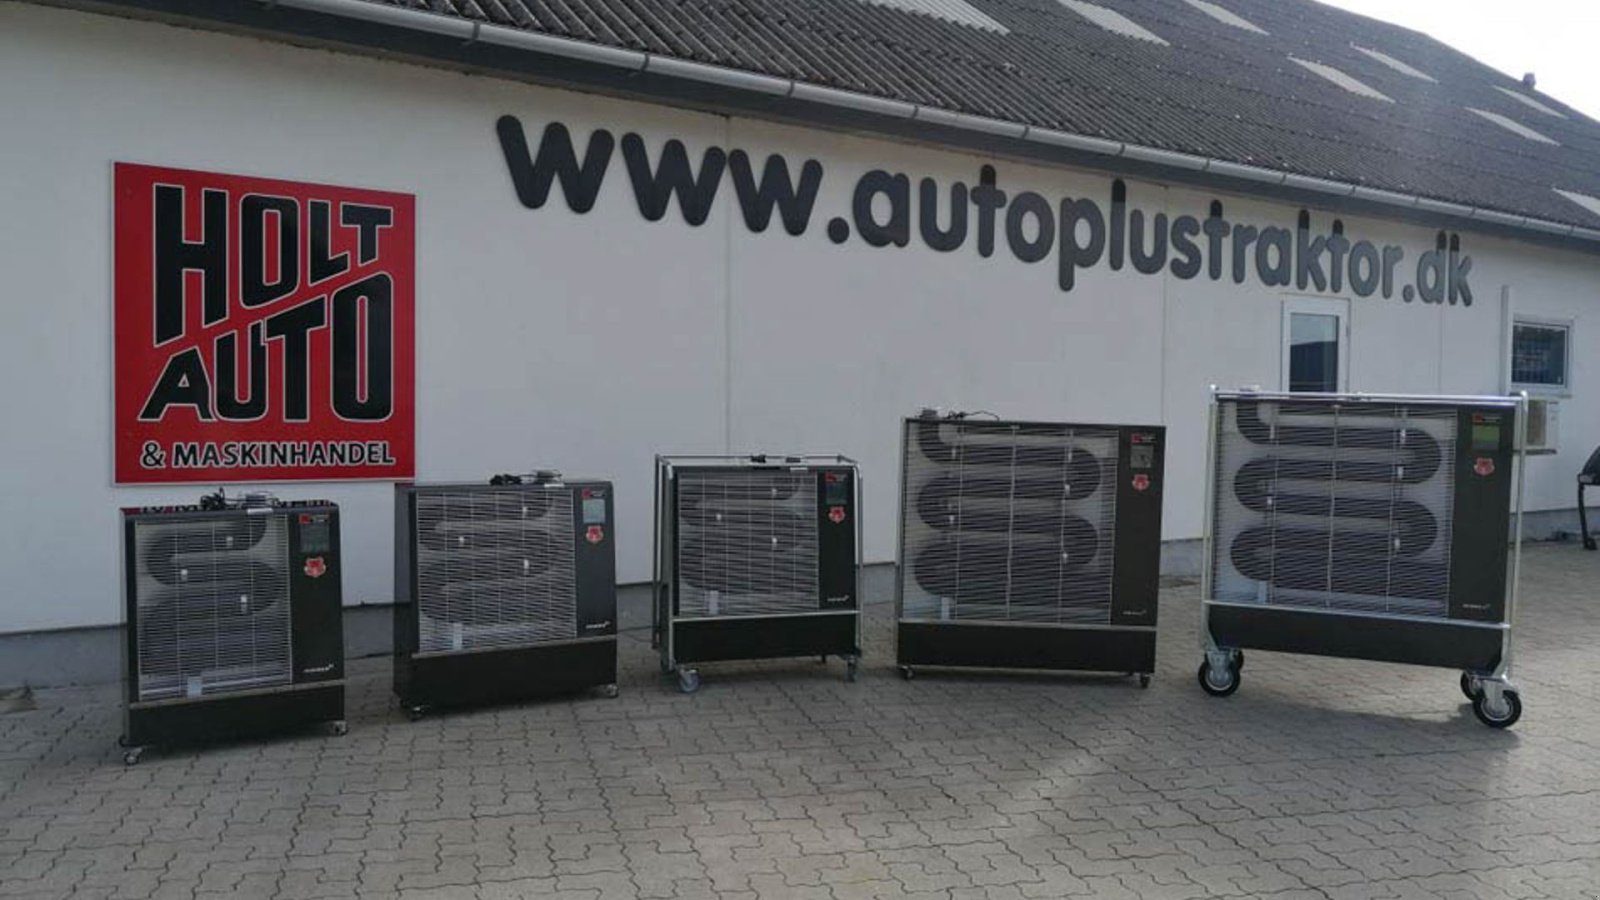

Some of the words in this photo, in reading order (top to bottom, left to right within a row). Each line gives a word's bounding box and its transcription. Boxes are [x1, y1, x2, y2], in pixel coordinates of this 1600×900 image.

[153, 183, 394, 348] HOLT
[496, 114, 1473, 307] www.autoplustraktor.dk
[137, 271, 394, 423] AUTO
[140, 440, 166, 469] &
[172, 441, 396, 468] MASKINHANDEL
